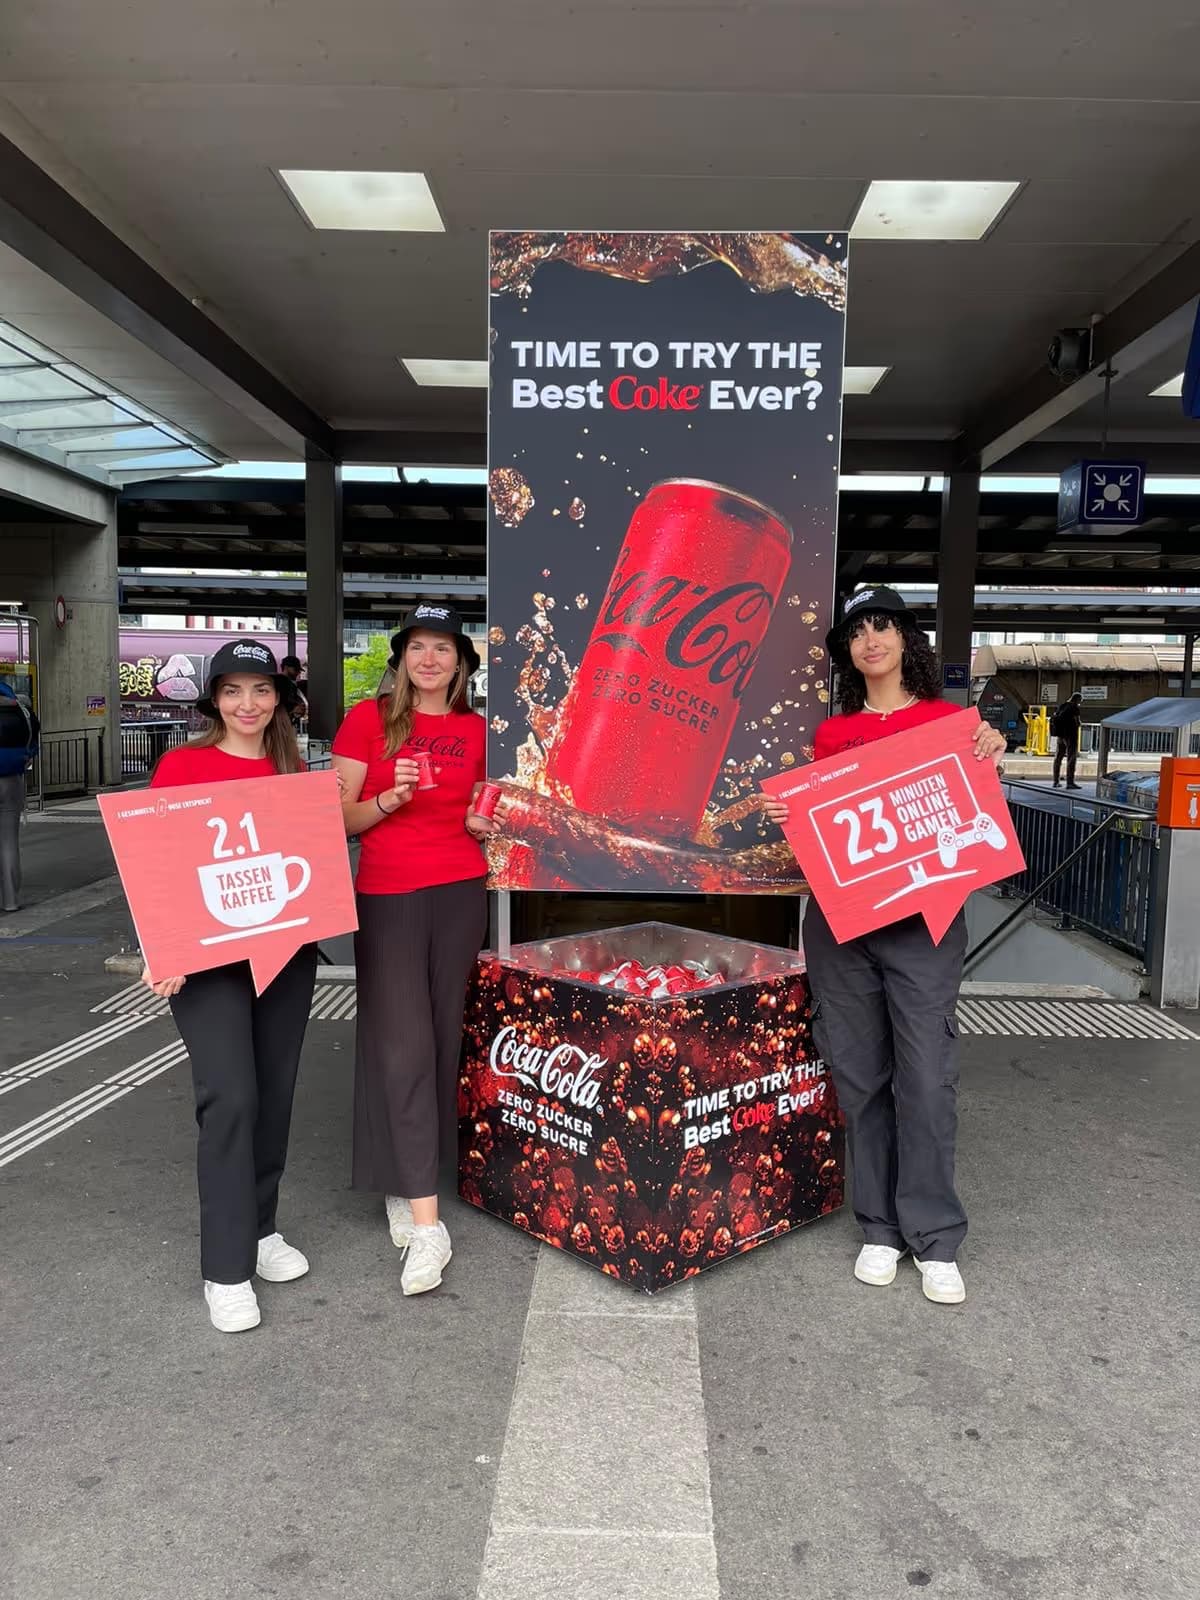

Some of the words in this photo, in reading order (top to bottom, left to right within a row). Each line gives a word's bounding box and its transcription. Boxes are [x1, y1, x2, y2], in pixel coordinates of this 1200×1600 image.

[511, 341, 601, 368] TIME
[610, 341, 660, 369] TO
[668, 341, 741, 369] TRY
[748, 342, 822, 369] THE
[512, 378, 604, 410] Best
[609, 375, 704, 411] Coke
[709, 380, 823, 410] Ever?
[593, 668, 641, 687] ZERO
[648, 678, 720, 720] ZUCKER
[649, 698, 711, 734] SUCRE
[833, 797, 898, 865] 23
[889, 773, 947, 807] MINUTEN
[897, 789, 954, 823] ONLINE
[206, 811, 260, 859] 2.1
[904, 807, 961, 842] GAMEN
[216, 866, 272, 891] TASSEN
[221, 885, 276, 911] KAFFEE
[490, 1025, 608, 1108] Coca-Cola
[684, 1088, 730, 1119] TIME
[733, 1081, 757, 1104] TO
[760, 1068, 792, 1094] TRY
[795, 1059, 826, 1082] THE
[497, 1089, 532, 1112] ZERO
[536, 1103, 593, 1137] ZUCKER
[684, 1114, 731, 1150] Best
[732, 1101, 776, 1132] Coke
[778, 1082, 827, 1116] Ever?
[540, 1125, 588, 1155] SUCRE
